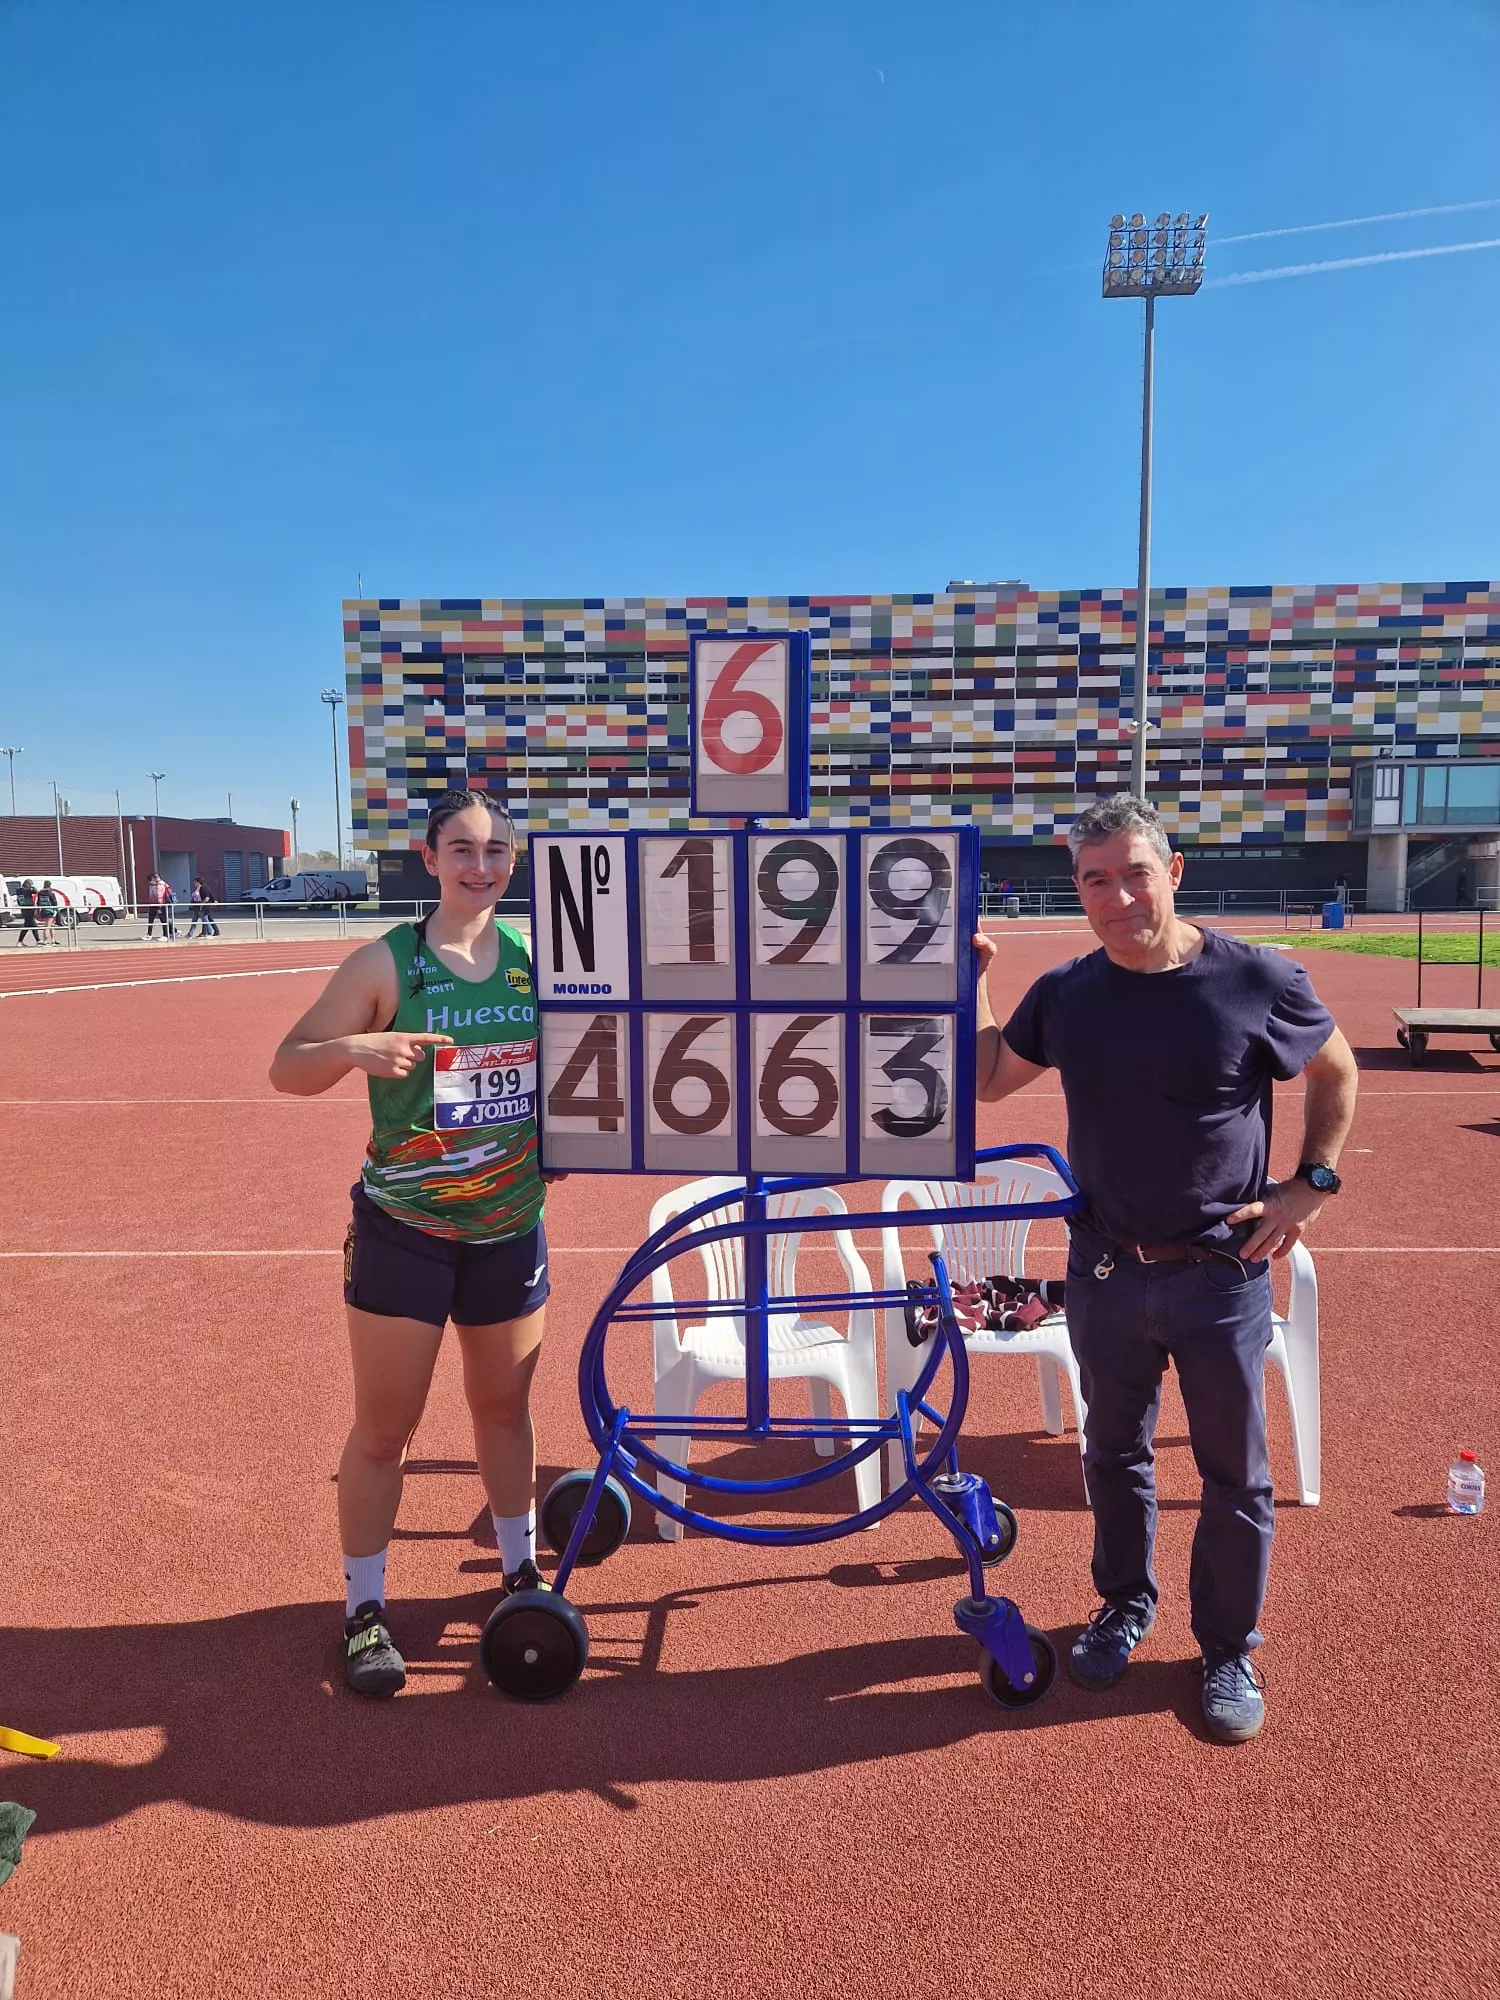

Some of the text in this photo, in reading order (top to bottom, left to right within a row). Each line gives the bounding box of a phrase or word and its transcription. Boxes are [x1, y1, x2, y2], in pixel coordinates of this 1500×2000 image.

[700, 642, 784, 775] 6
[553, 983, 612, 994] MONDO
[426, 1003, 535, 1032] Huesca
[469, 1068, 520, 1099] 199
[347, 1624, 379, 1657] NIKE
